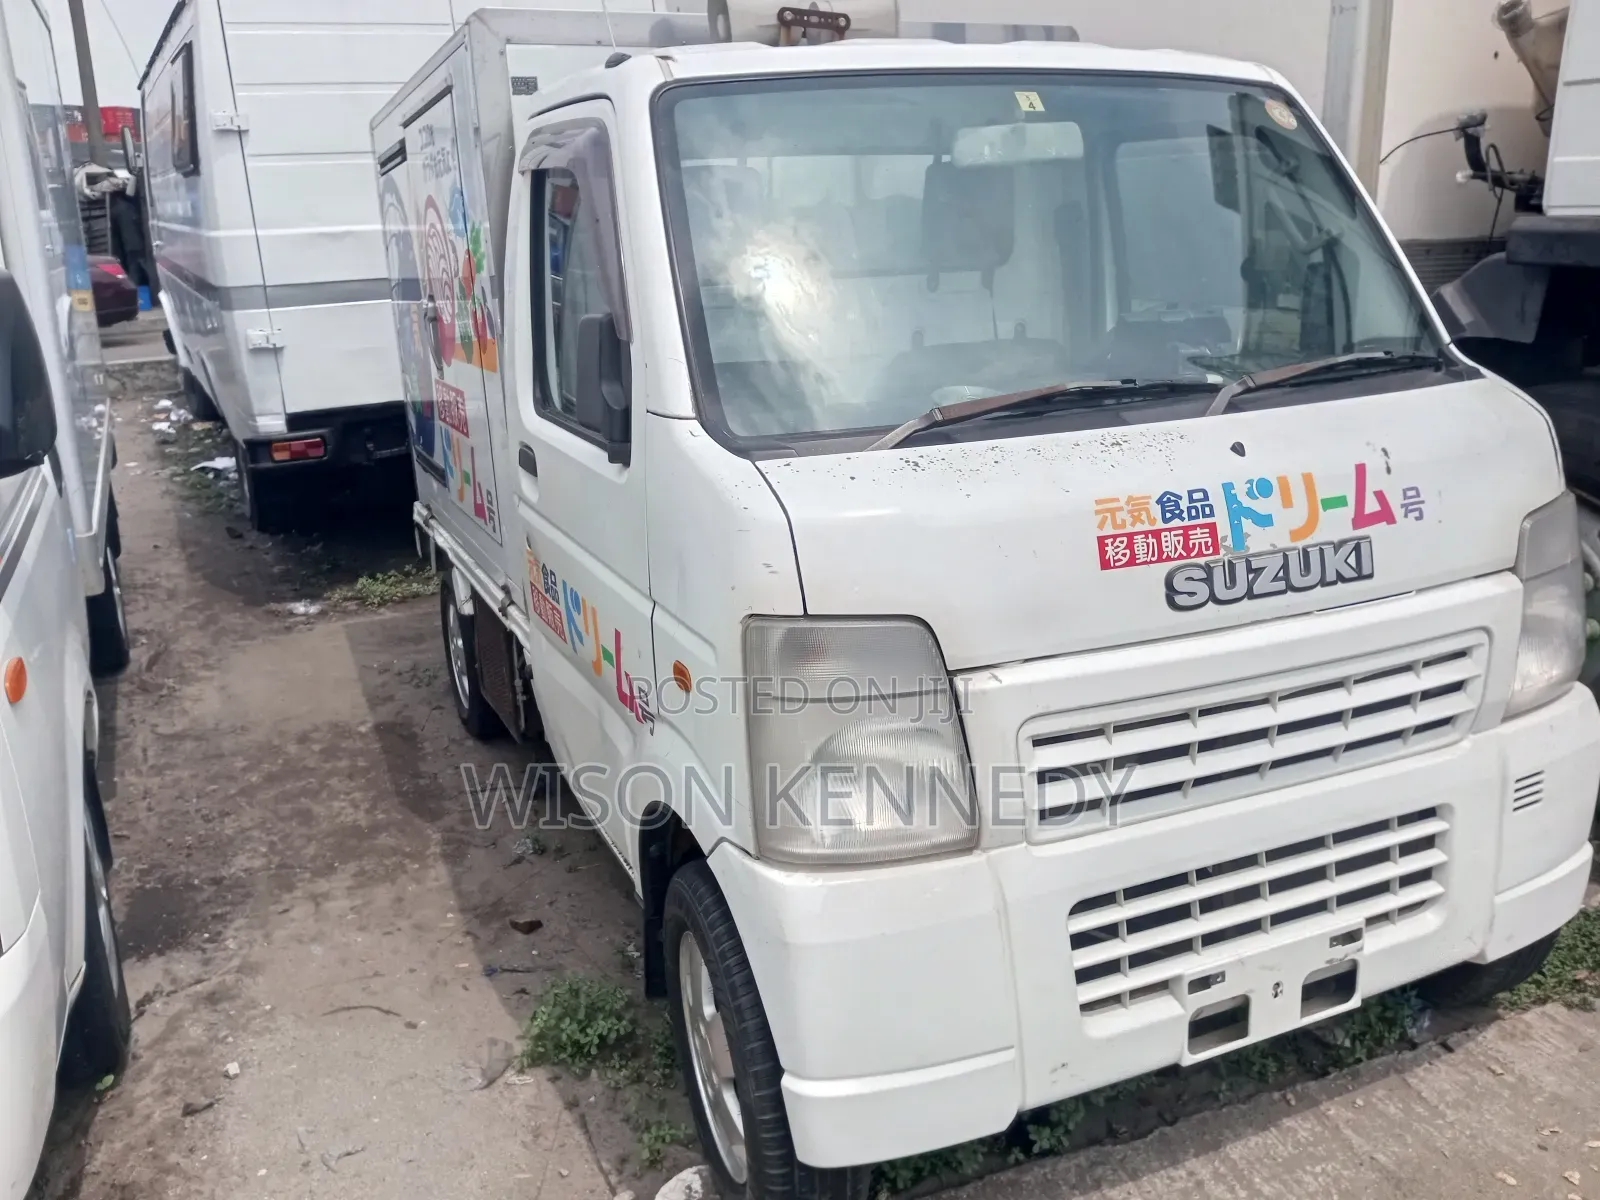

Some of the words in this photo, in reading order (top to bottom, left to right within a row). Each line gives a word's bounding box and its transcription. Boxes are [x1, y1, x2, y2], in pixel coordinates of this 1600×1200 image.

[1094, 488, 1215, 531] 元気食品
[1103, 526, 1215, 568] 移動販売
[1164, 535, 1374, 612] SUZUKI
